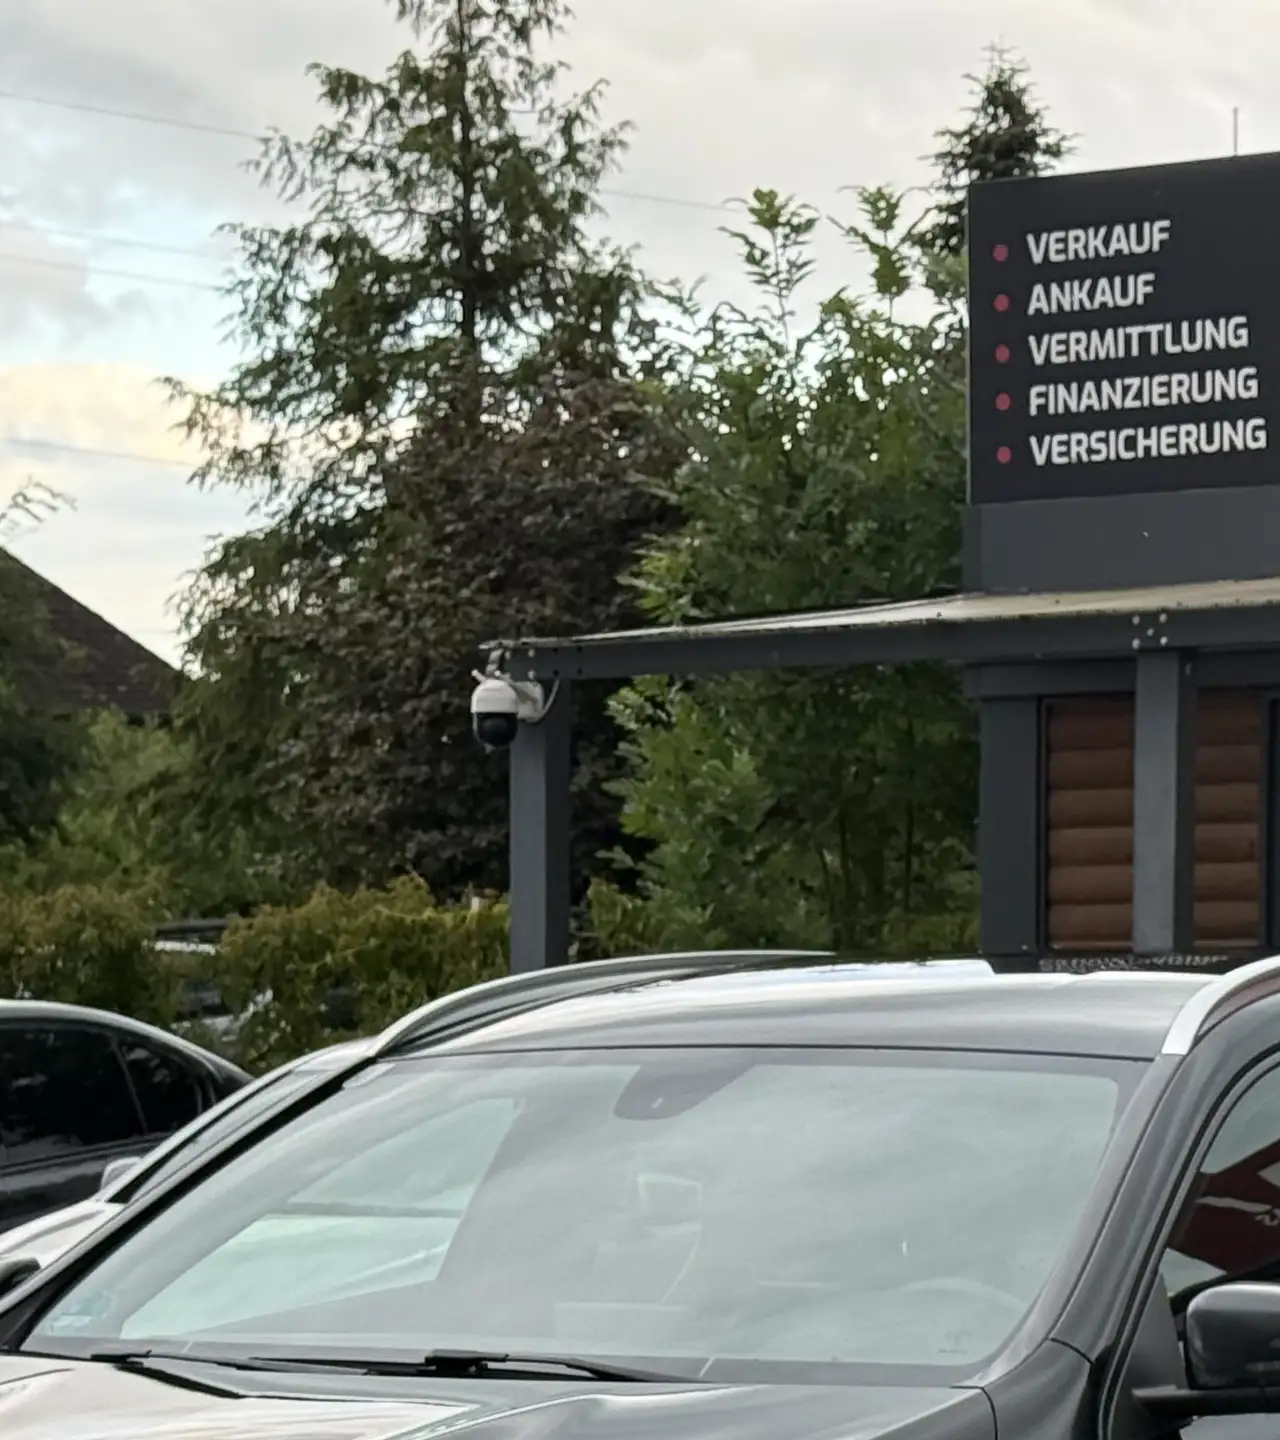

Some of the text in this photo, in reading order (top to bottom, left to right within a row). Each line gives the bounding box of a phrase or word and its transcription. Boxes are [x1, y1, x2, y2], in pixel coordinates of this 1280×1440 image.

[1025, 218, 1172, 265] VERKAUF
[1027, 272, 1156, 316] ANKAUF
[1027, 315, 1250, 366] VERMITTLUNG
[1028, 366, 1260, 416] FINANZIERUNG
[1028, 417, 1268, 467] VERSICHERUNG
